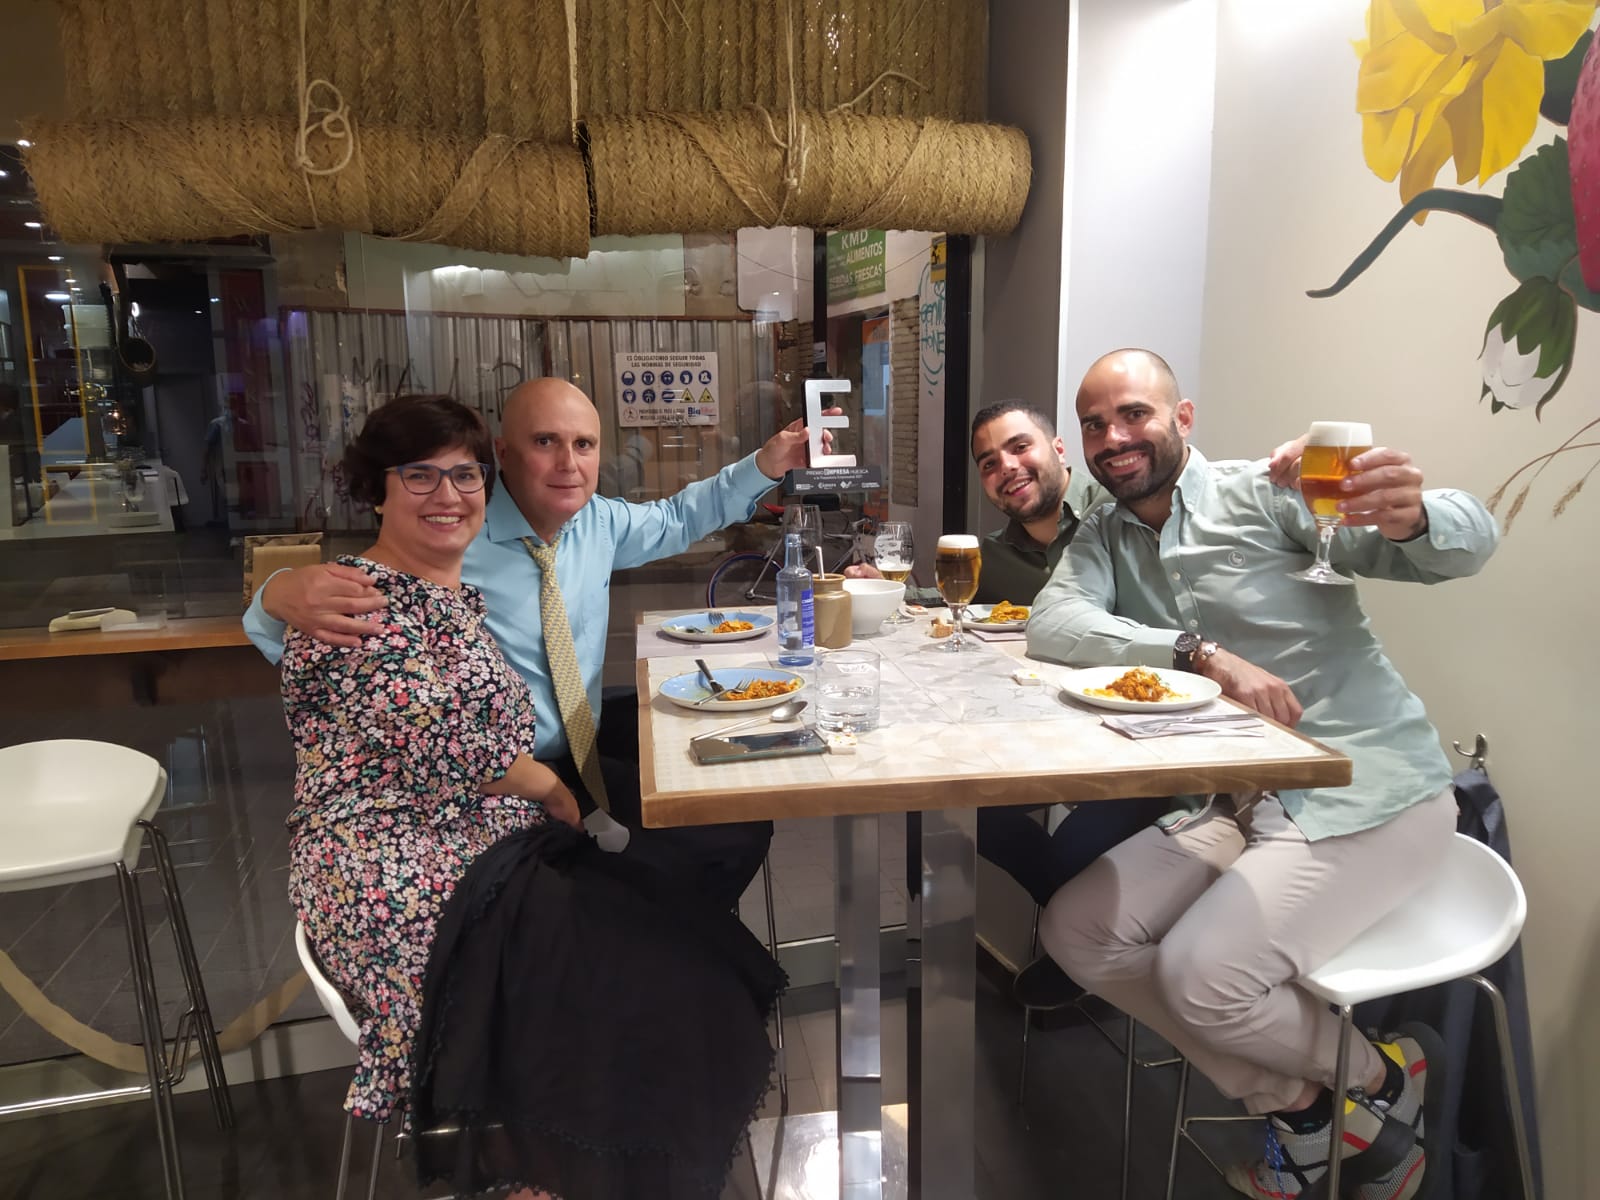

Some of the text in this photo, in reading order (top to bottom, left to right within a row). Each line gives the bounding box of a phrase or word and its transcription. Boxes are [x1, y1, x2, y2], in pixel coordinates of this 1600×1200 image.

[841, 229, 868, 250] KMD
[846, 241, 883, 264] ALIMENTOS
[855, 263, 883, 283] FRESCAS
[805, 379, 857, 468] E
